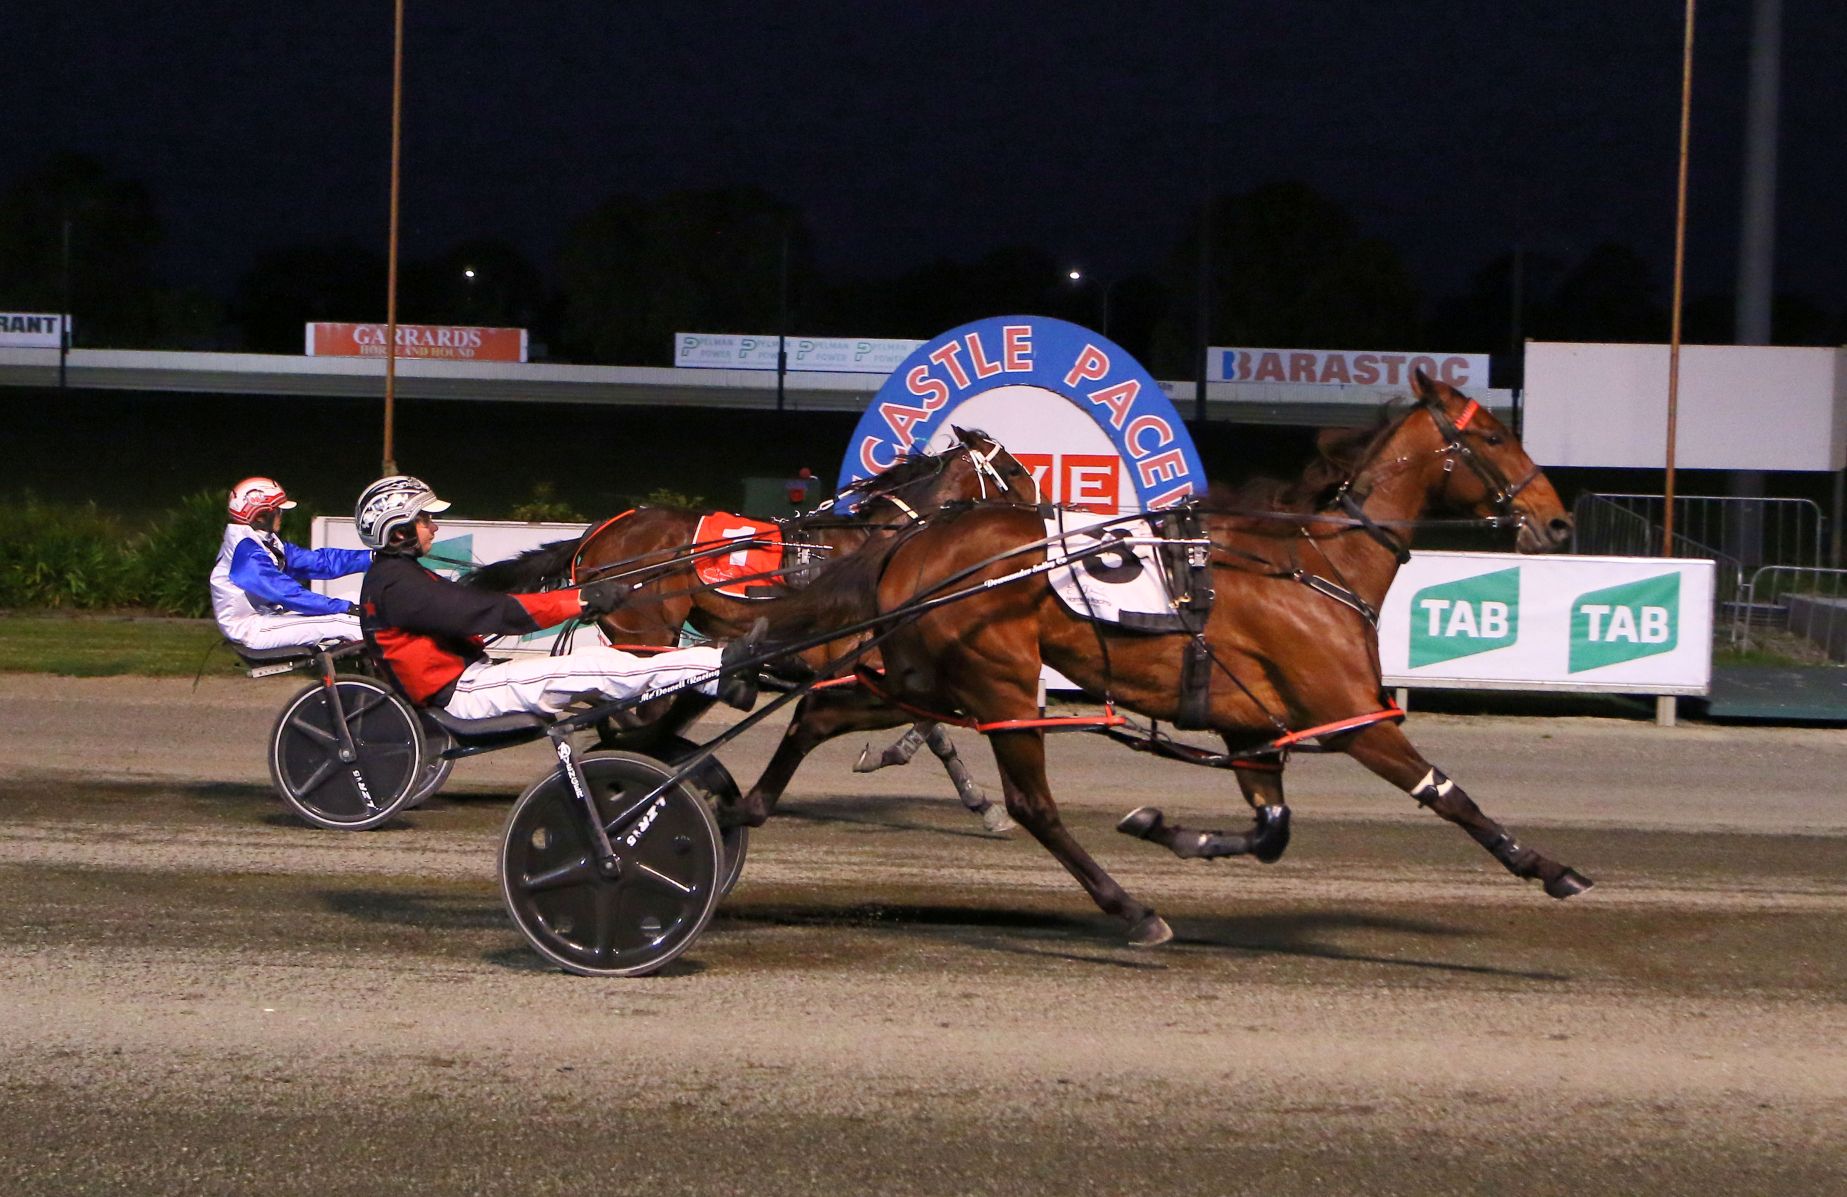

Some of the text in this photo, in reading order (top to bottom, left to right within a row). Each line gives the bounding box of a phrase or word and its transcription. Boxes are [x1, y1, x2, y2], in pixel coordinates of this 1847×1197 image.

[1222, 351, 1469, 387] BARASTOC
[722, 526, 756, 566] 1
[1420, 599, 1508, 638] TAB
[1580, 604, 1668, 643] TAB
